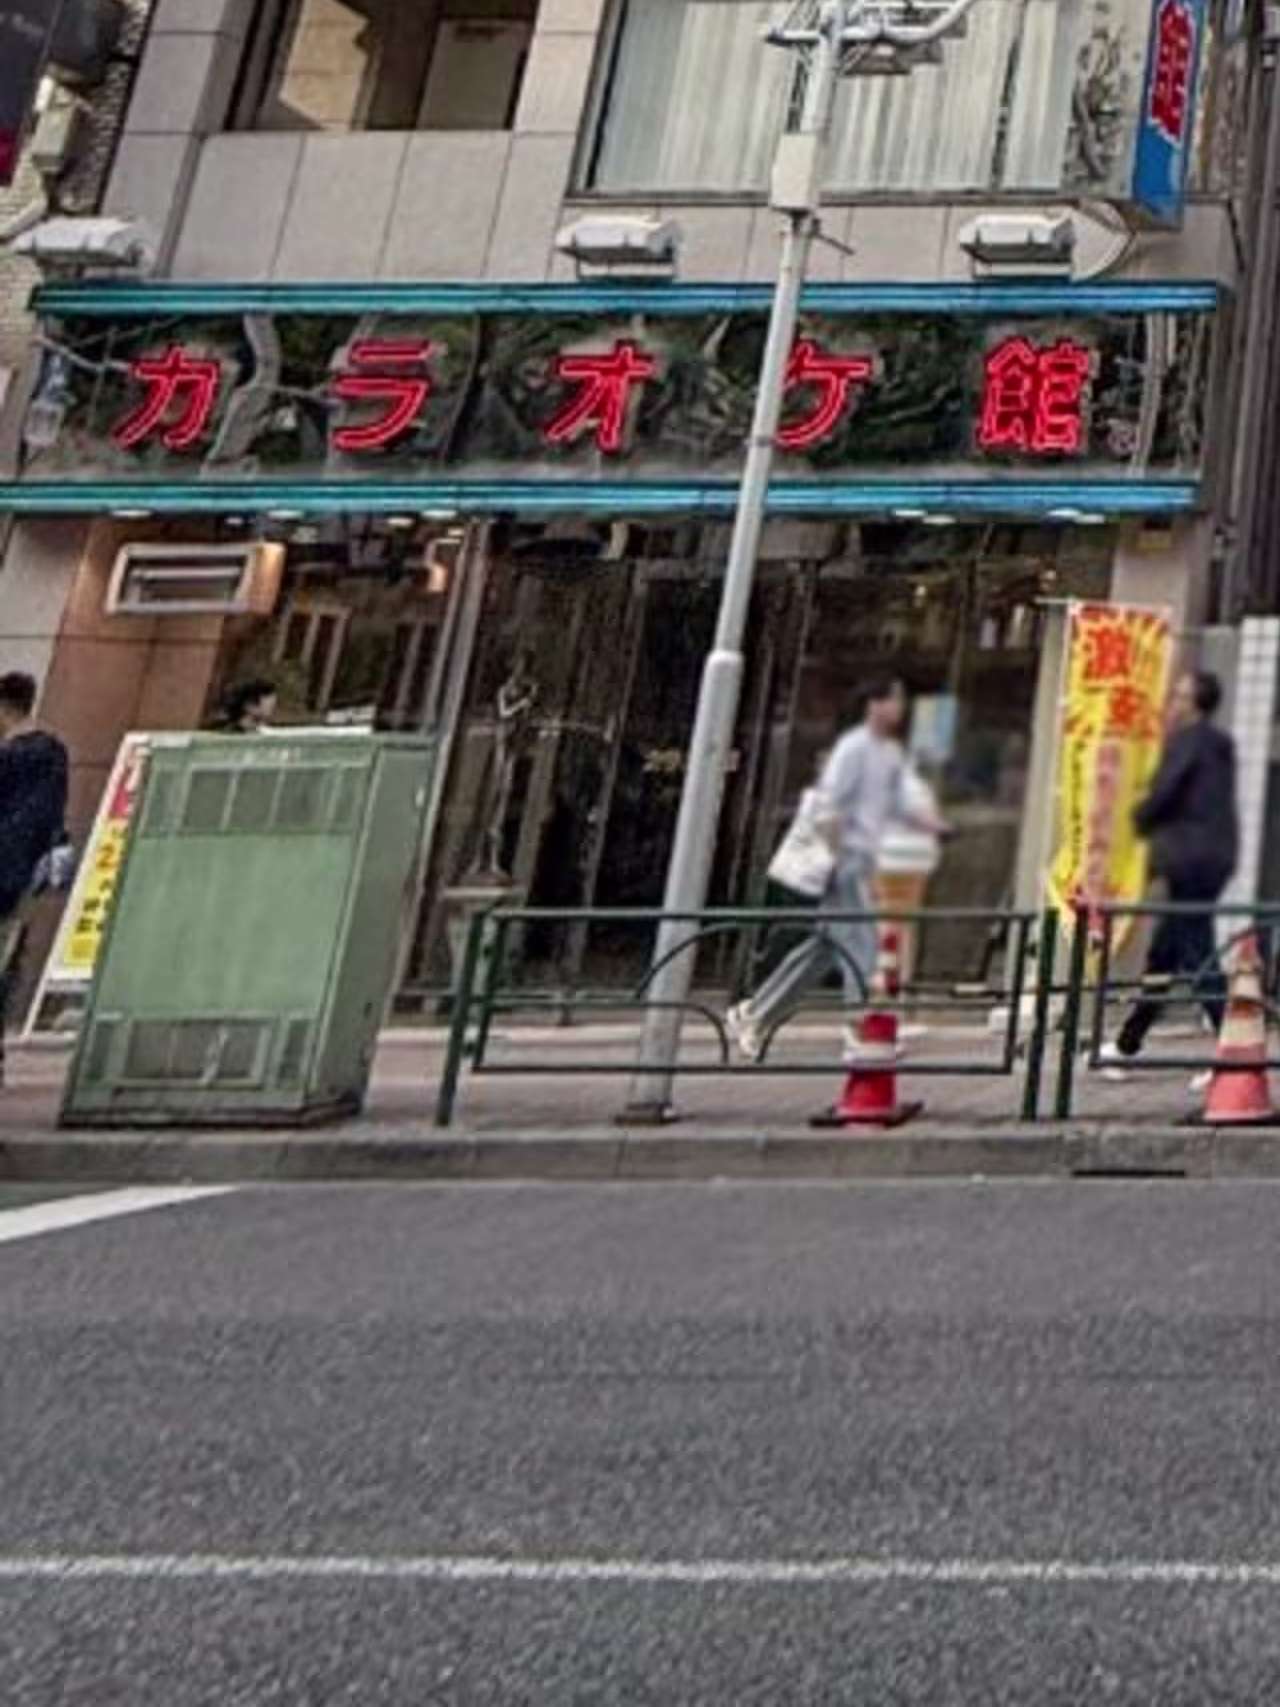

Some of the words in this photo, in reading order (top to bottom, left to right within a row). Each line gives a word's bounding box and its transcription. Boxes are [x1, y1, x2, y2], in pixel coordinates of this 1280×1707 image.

[114, 339, 1094, 455] カラオケ館
